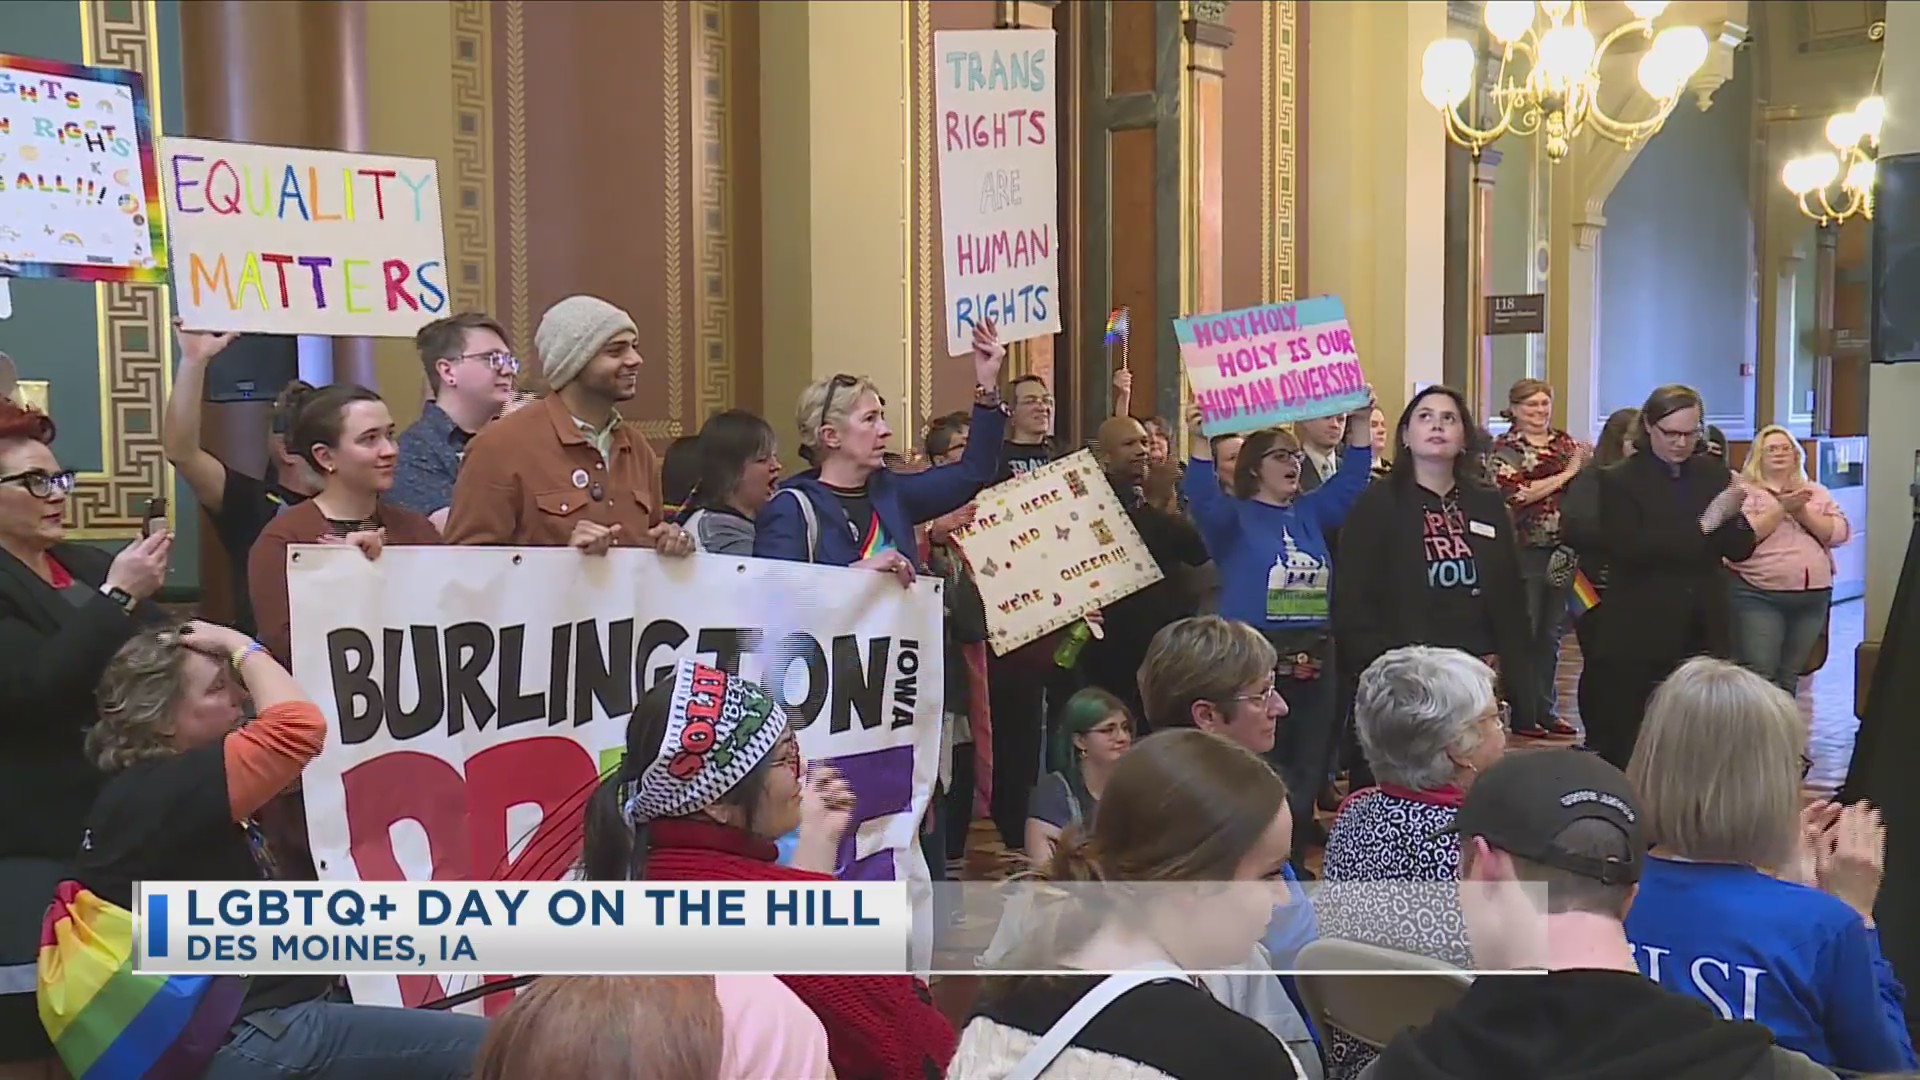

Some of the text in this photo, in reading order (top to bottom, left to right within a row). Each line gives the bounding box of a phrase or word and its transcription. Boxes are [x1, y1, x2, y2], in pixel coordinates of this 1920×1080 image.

[946, 49, 1046, 92] TRANS
[33, 117, 131, 157] RIGHTS
[946, 110, 1046, 151] RIGHTS
[172, 154, 430, 222] EQUALITY
[980, 169, 1022, 214] ARE
[957, 223, 1049, 276] HUMAN
[189, 251, 446, 313] MATTERS
[1495, 297, 1515, 310] 118
[956, 284, 1049, 338] RIGHTS
[1217, 329, 1355, 378] HOLY IS OUR
[1197, 377, 1279, 424] HUMAN
[1020, 489, 1063, 515] HERE
[1009, 527, 1041, 553] AND
[1060, 545, 1130, 581] QUEER!!!
[1428, 559, 1477, 587] YOU
[891, 638, 920, 731] IOWA
